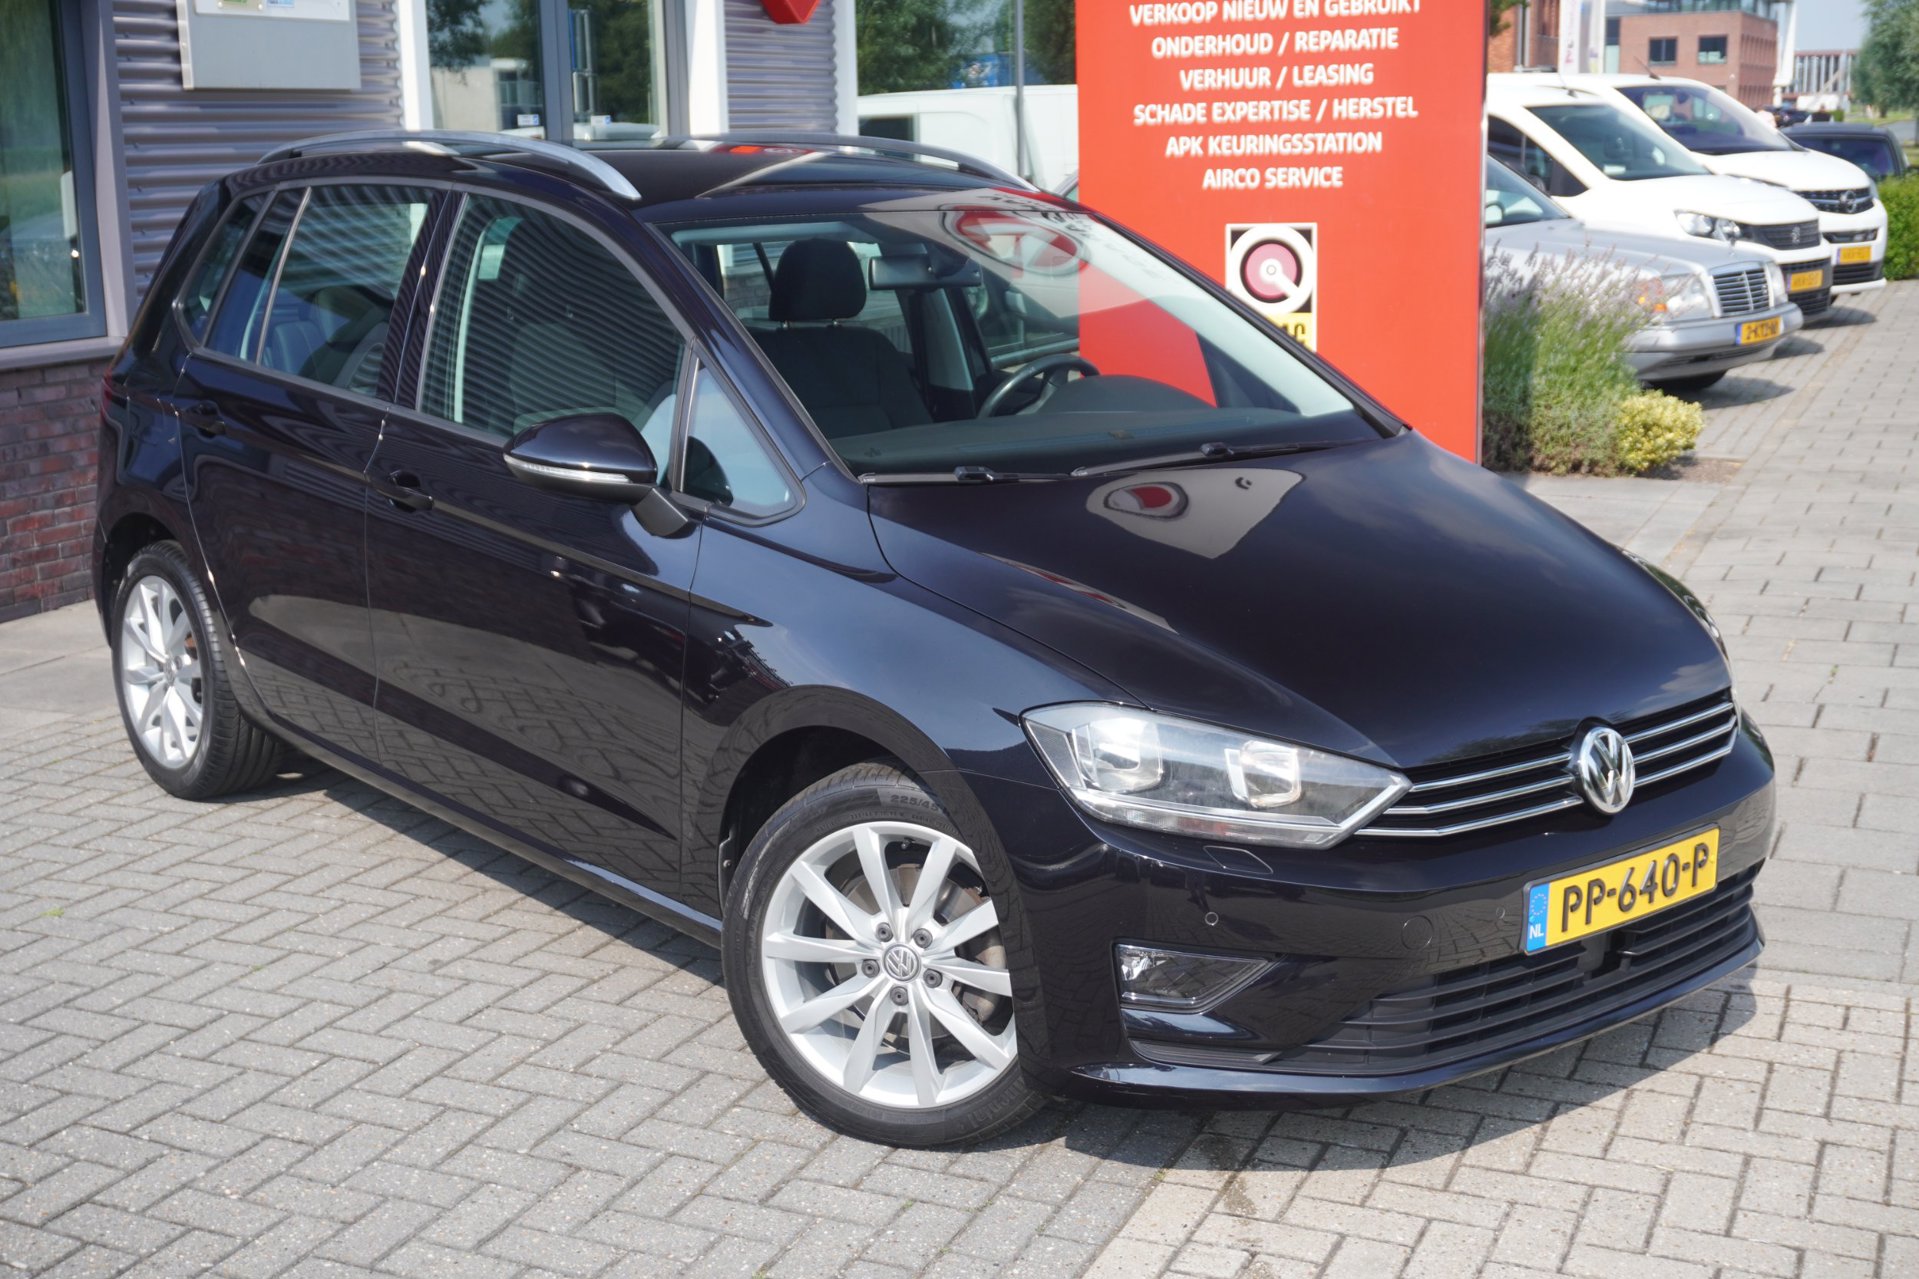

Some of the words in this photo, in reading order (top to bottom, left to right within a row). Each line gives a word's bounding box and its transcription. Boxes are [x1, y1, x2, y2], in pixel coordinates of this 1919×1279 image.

[1130, 1, 1218, 26] VERKOOP
[1222, 0, 1289, 21] NIEUW
[1293, 0, 1319, 18] EN
[1152, 33, 1273, 59] ONDERHOUD
[1277, 32, 1290, 56] /
[1294, 27, 1399, 53] REPARATIE
[1179, 67, 1271, 91] VERHUUR
[1276, 66, 1288, 90] /
[1292, 63, 1374, 87] LEASING
[1134, 102, 1207, 126] SCHADE
[1212, 99, 1311, 123] EXPERTISE
[1315, 99, 1327, 123] /
[1332, 96, 1418, 120] HERSTEL
[1165, 135, 1204, 158] APK
[1208, 131, 1382, 156] KEURINGSSTATION
[1202, 168, 1260, 190] AIRCO
[1264, 166, 1343, 189] SERVICE
[1561, 842, 1709, 932] PP-640-P
[1529, 923, 1544, 939] NL
